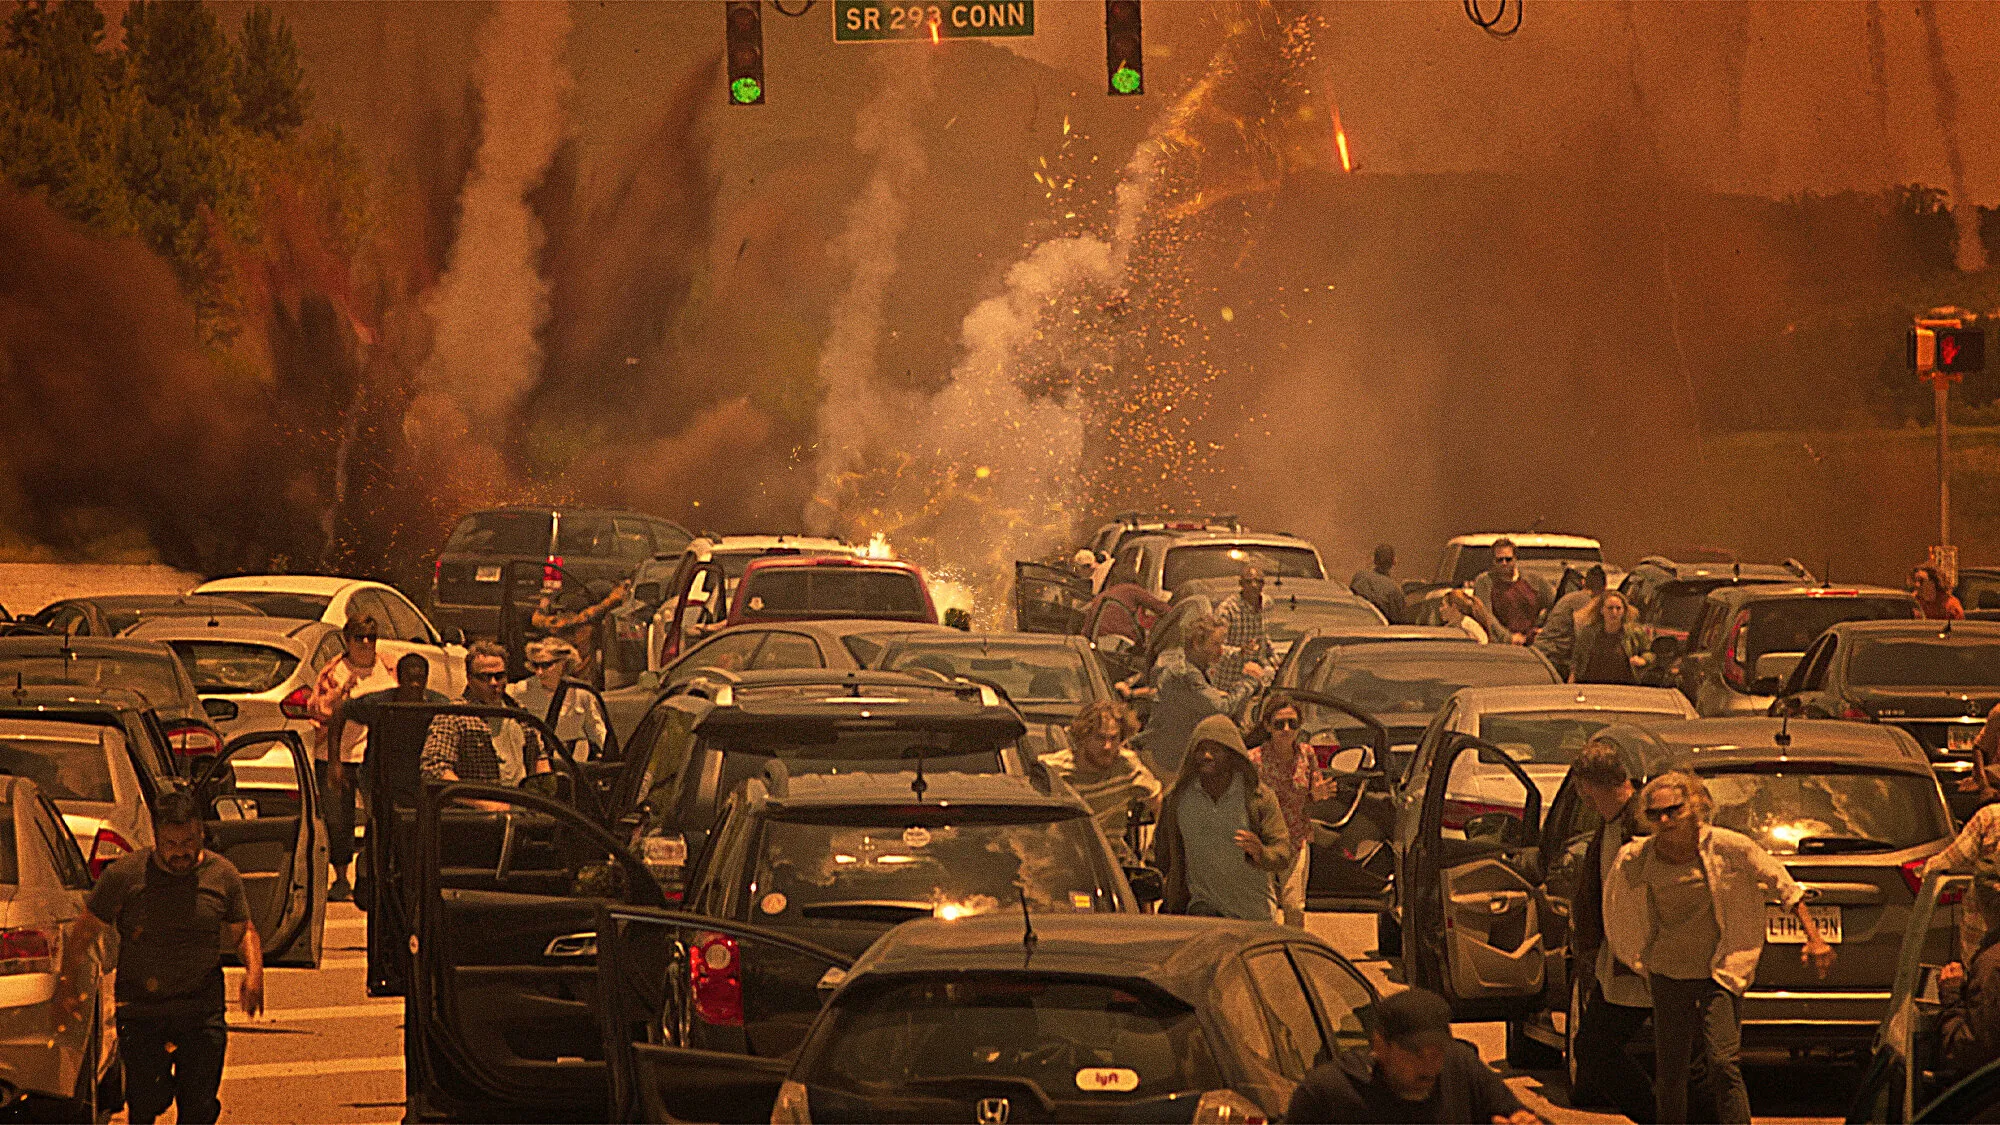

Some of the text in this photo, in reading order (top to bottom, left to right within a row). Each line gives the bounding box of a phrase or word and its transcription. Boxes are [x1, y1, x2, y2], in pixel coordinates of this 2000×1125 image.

[846, 2, 1025, 31] SR 293 CONN
